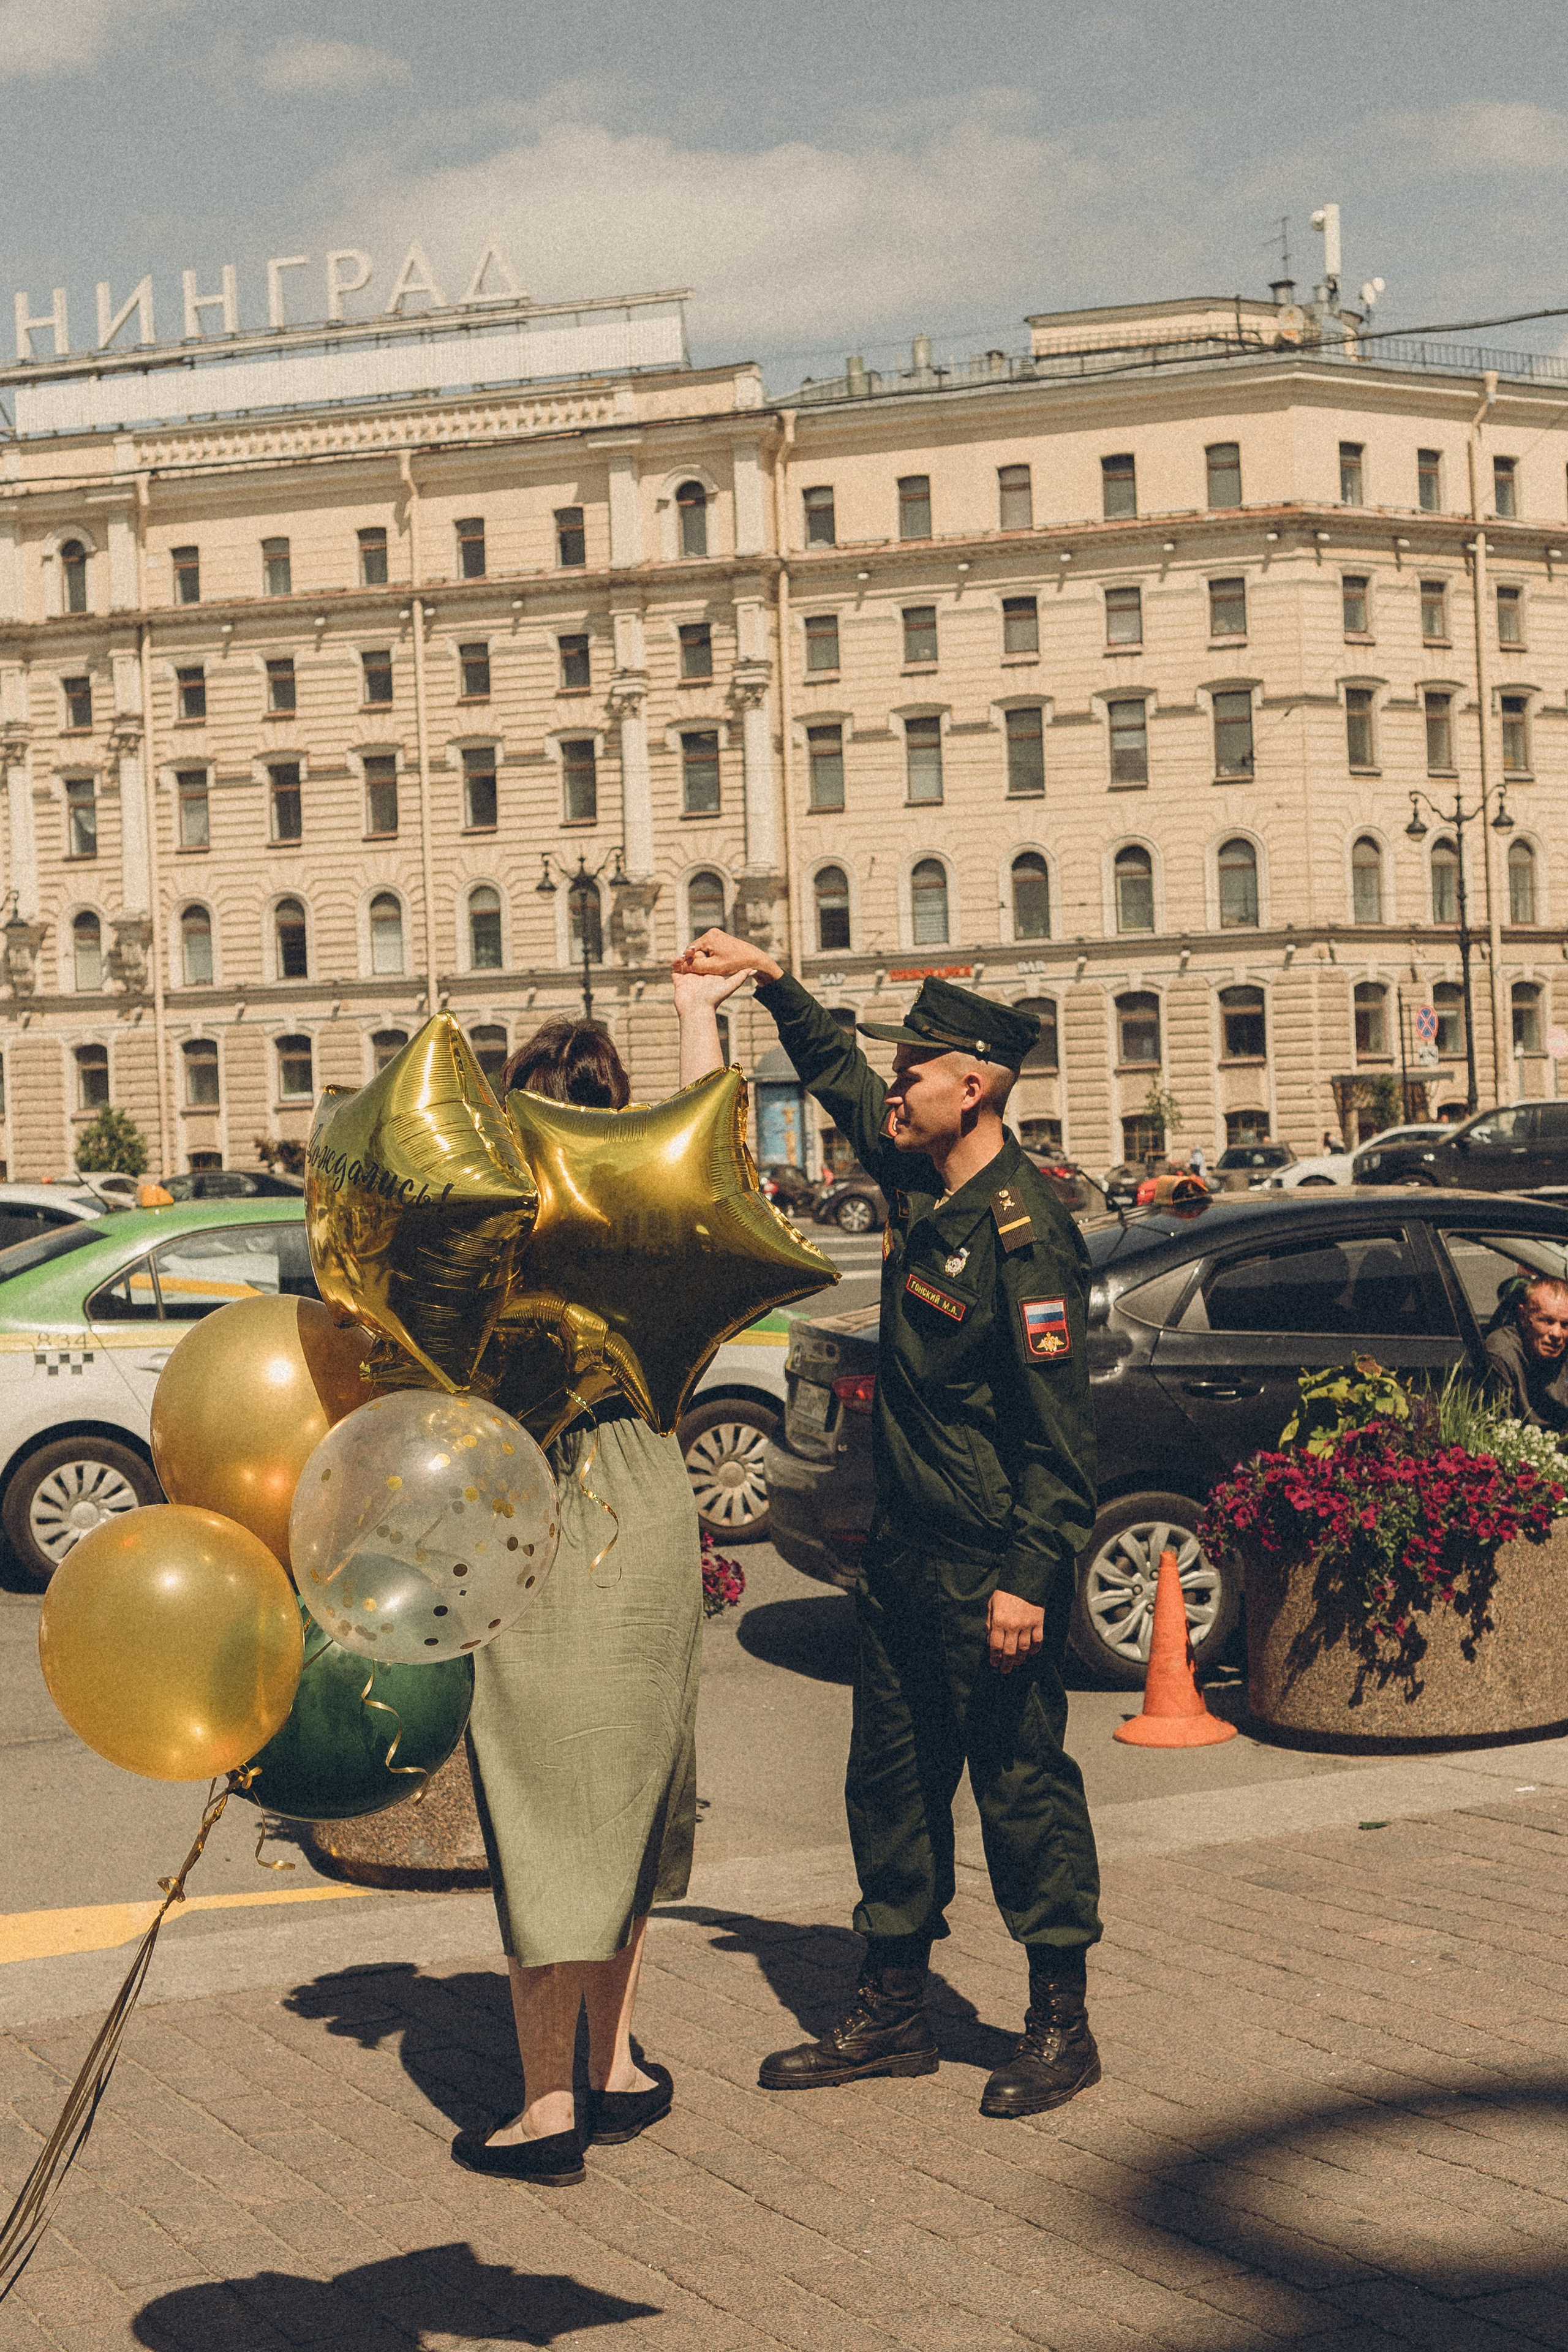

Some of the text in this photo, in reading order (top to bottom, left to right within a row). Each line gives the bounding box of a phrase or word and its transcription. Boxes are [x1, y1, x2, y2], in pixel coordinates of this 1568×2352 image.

[14, 238, 530, 360] НИНГРАД
[911, 1281, 957, 1316] ГОНСКИЙ М.А.
